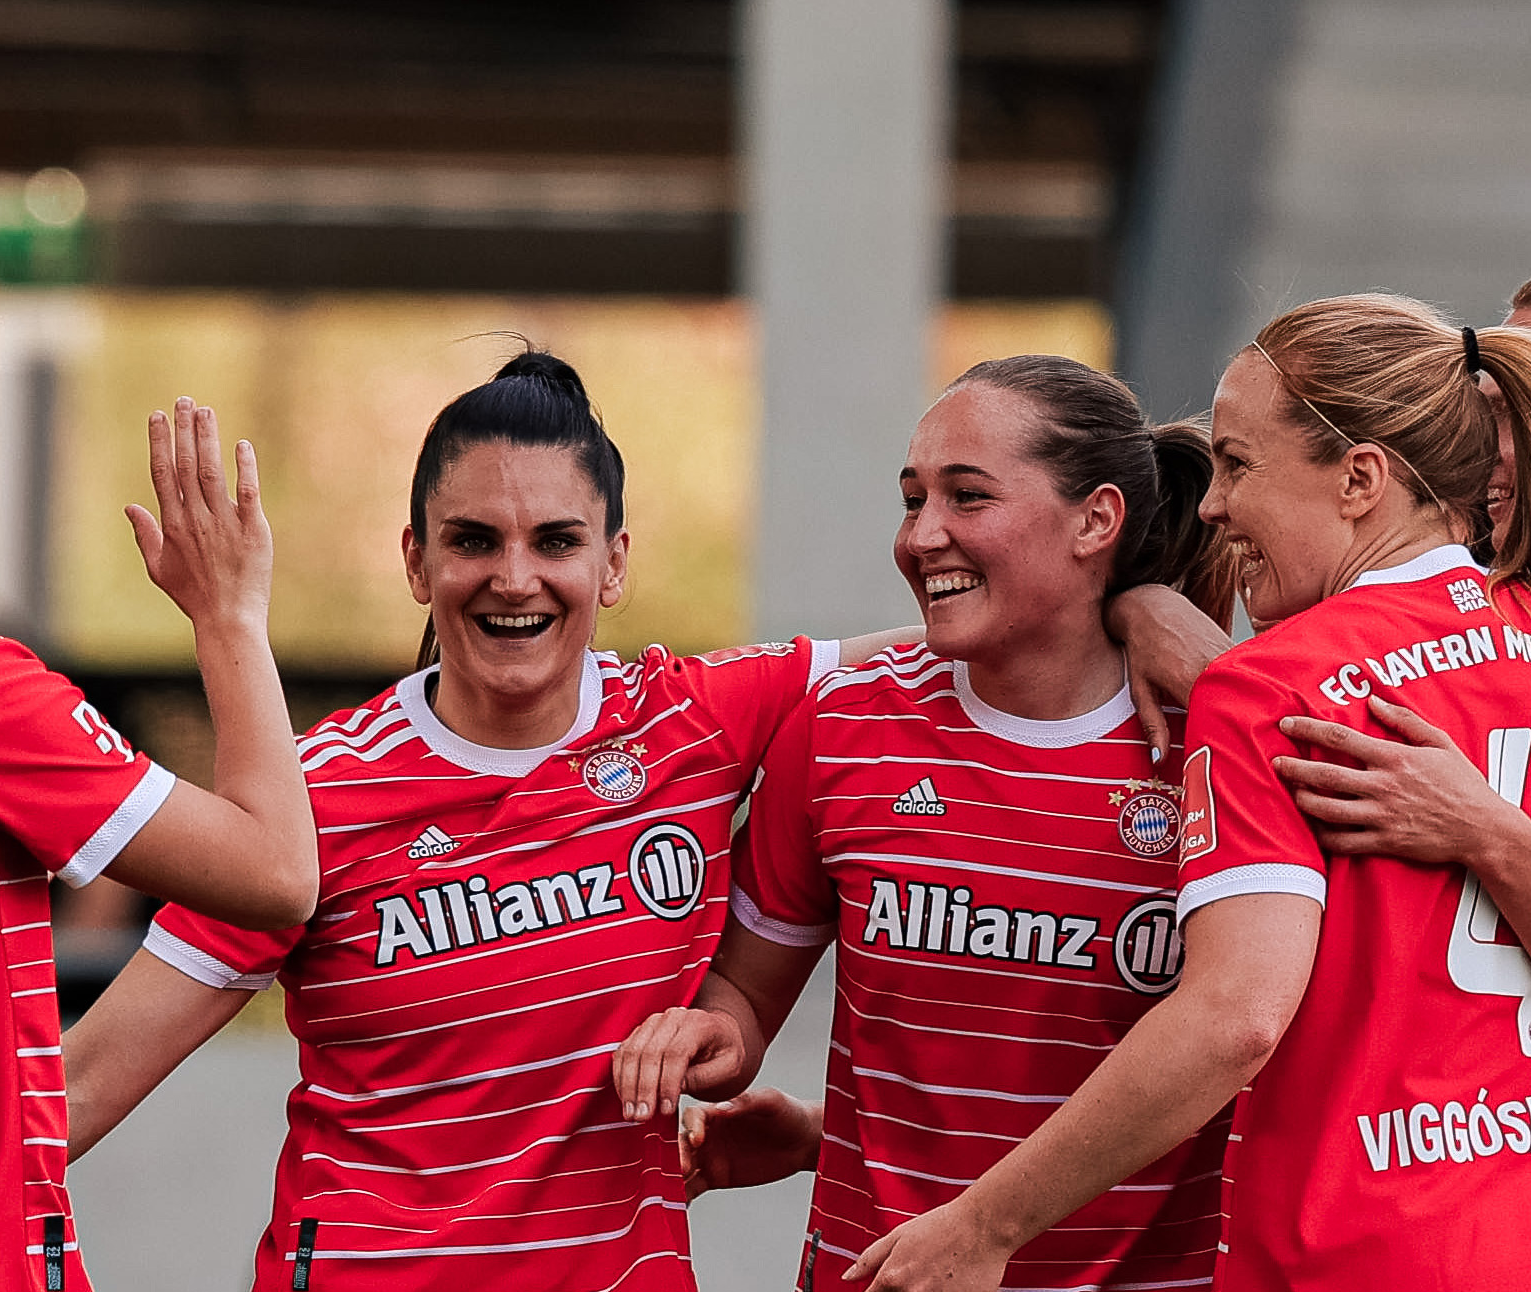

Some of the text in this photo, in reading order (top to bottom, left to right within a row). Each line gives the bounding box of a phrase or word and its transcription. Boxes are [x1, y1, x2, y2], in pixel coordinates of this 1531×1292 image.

[1446, 578, 1480, 595] MIA
[1451, 588, 1485, 605] SAN
[1456, 597, 1490, 614] MIA
[1318, 662, 1371, 706] FC
[1364, 625, 1498, 688] BAYERN
[593, 754, 636, 768] BAYERN
[892, 799, 946, 815] adidas
[1125, 797, 1178, 824] FC BAYERN
[375, 863, 625, 967] Allianz
[862, 878, 1099, 969] Allianz
